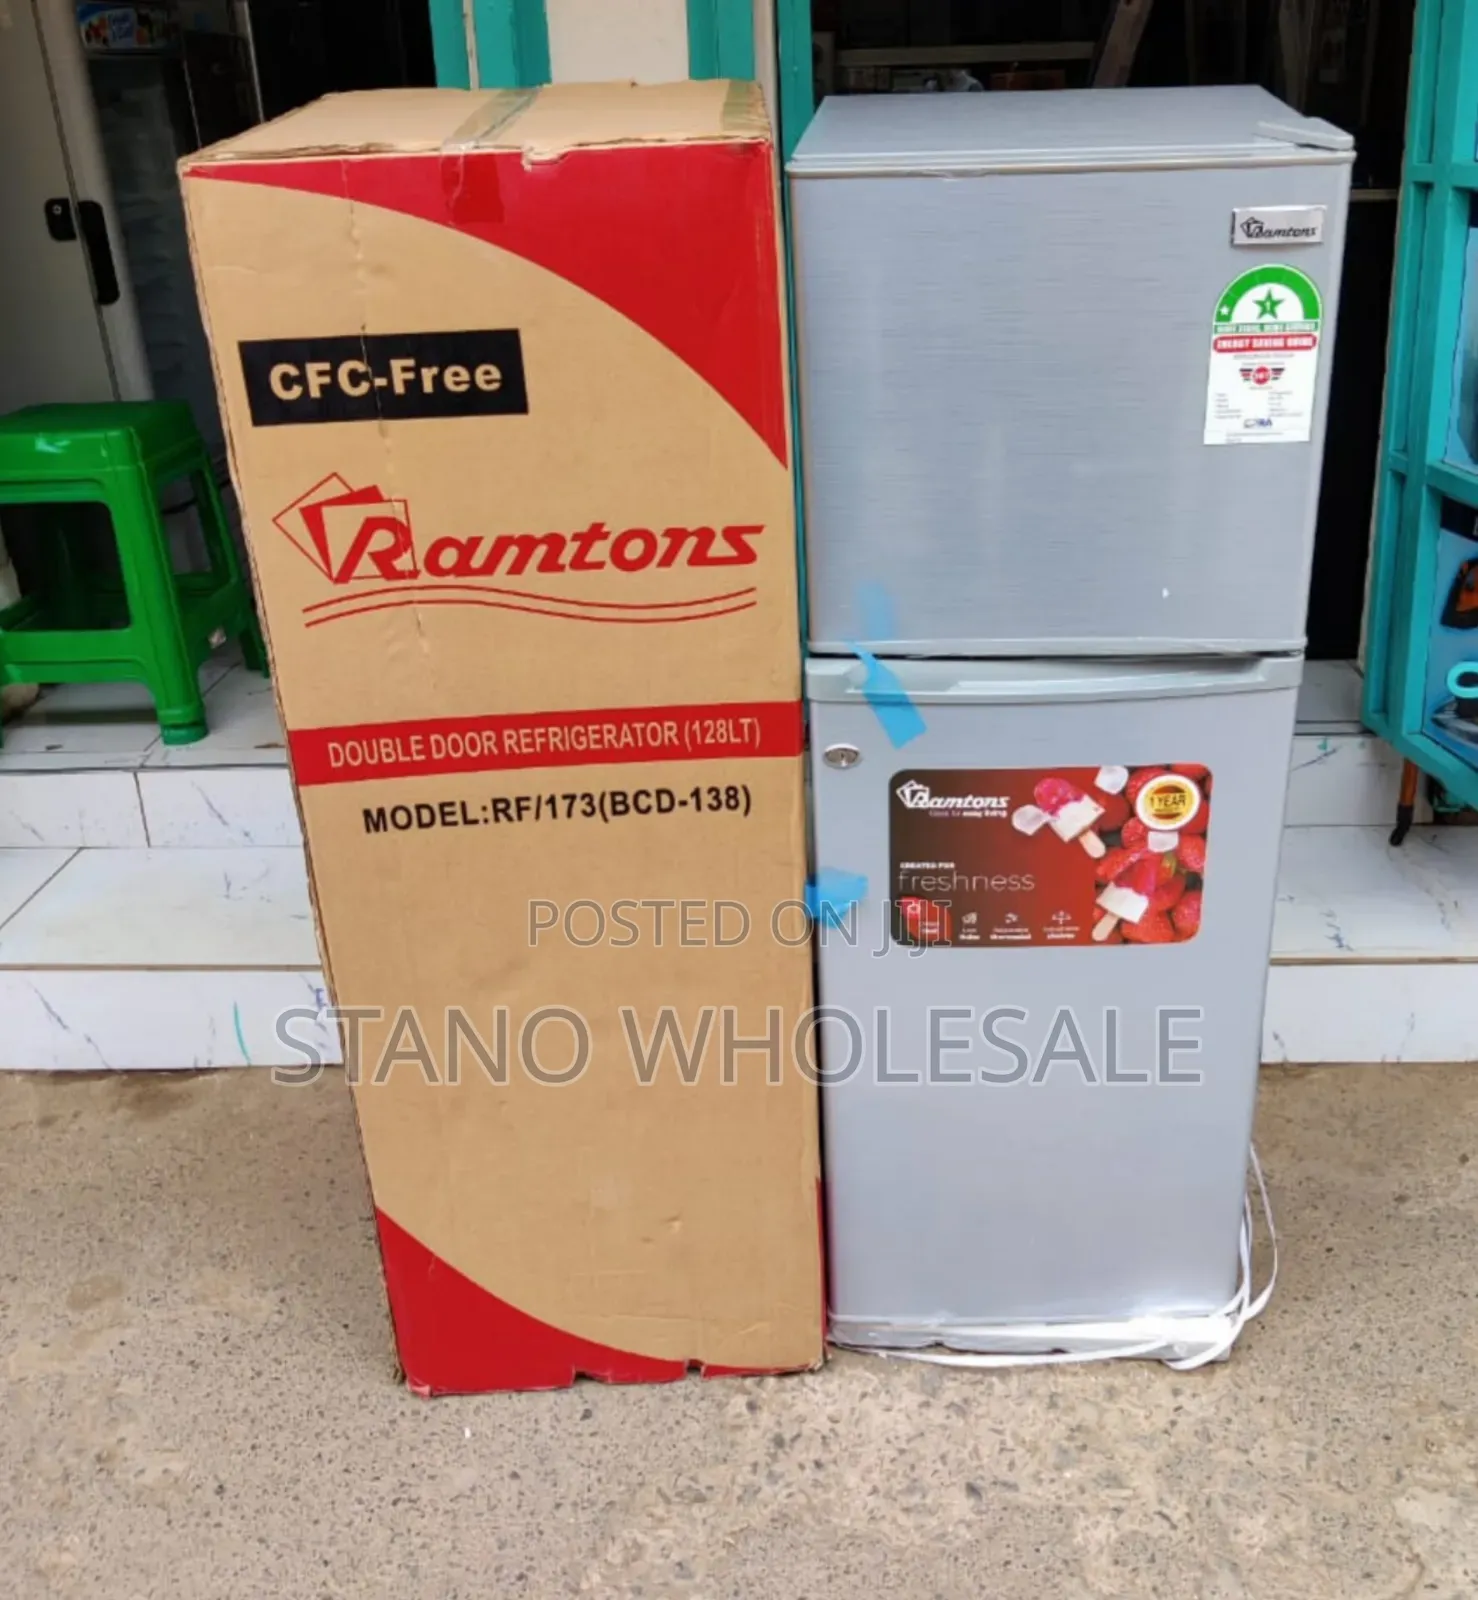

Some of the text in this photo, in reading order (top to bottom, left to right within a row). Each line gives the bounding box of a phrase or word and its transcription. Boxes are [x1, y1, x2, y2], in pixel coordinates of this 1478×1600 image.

[1246, 220, 1318, 239] Ramtons
[269, 357, 503, 401] CFC-Free
[315, 506, 765, 583] Ramtons
[327, 717, 762, 768] DOUBLE DOOR REFRIGERATOR (128LT)
[904, 785, 1011, 809] Ramtons
[897, 870, 1035, 892] freshness
